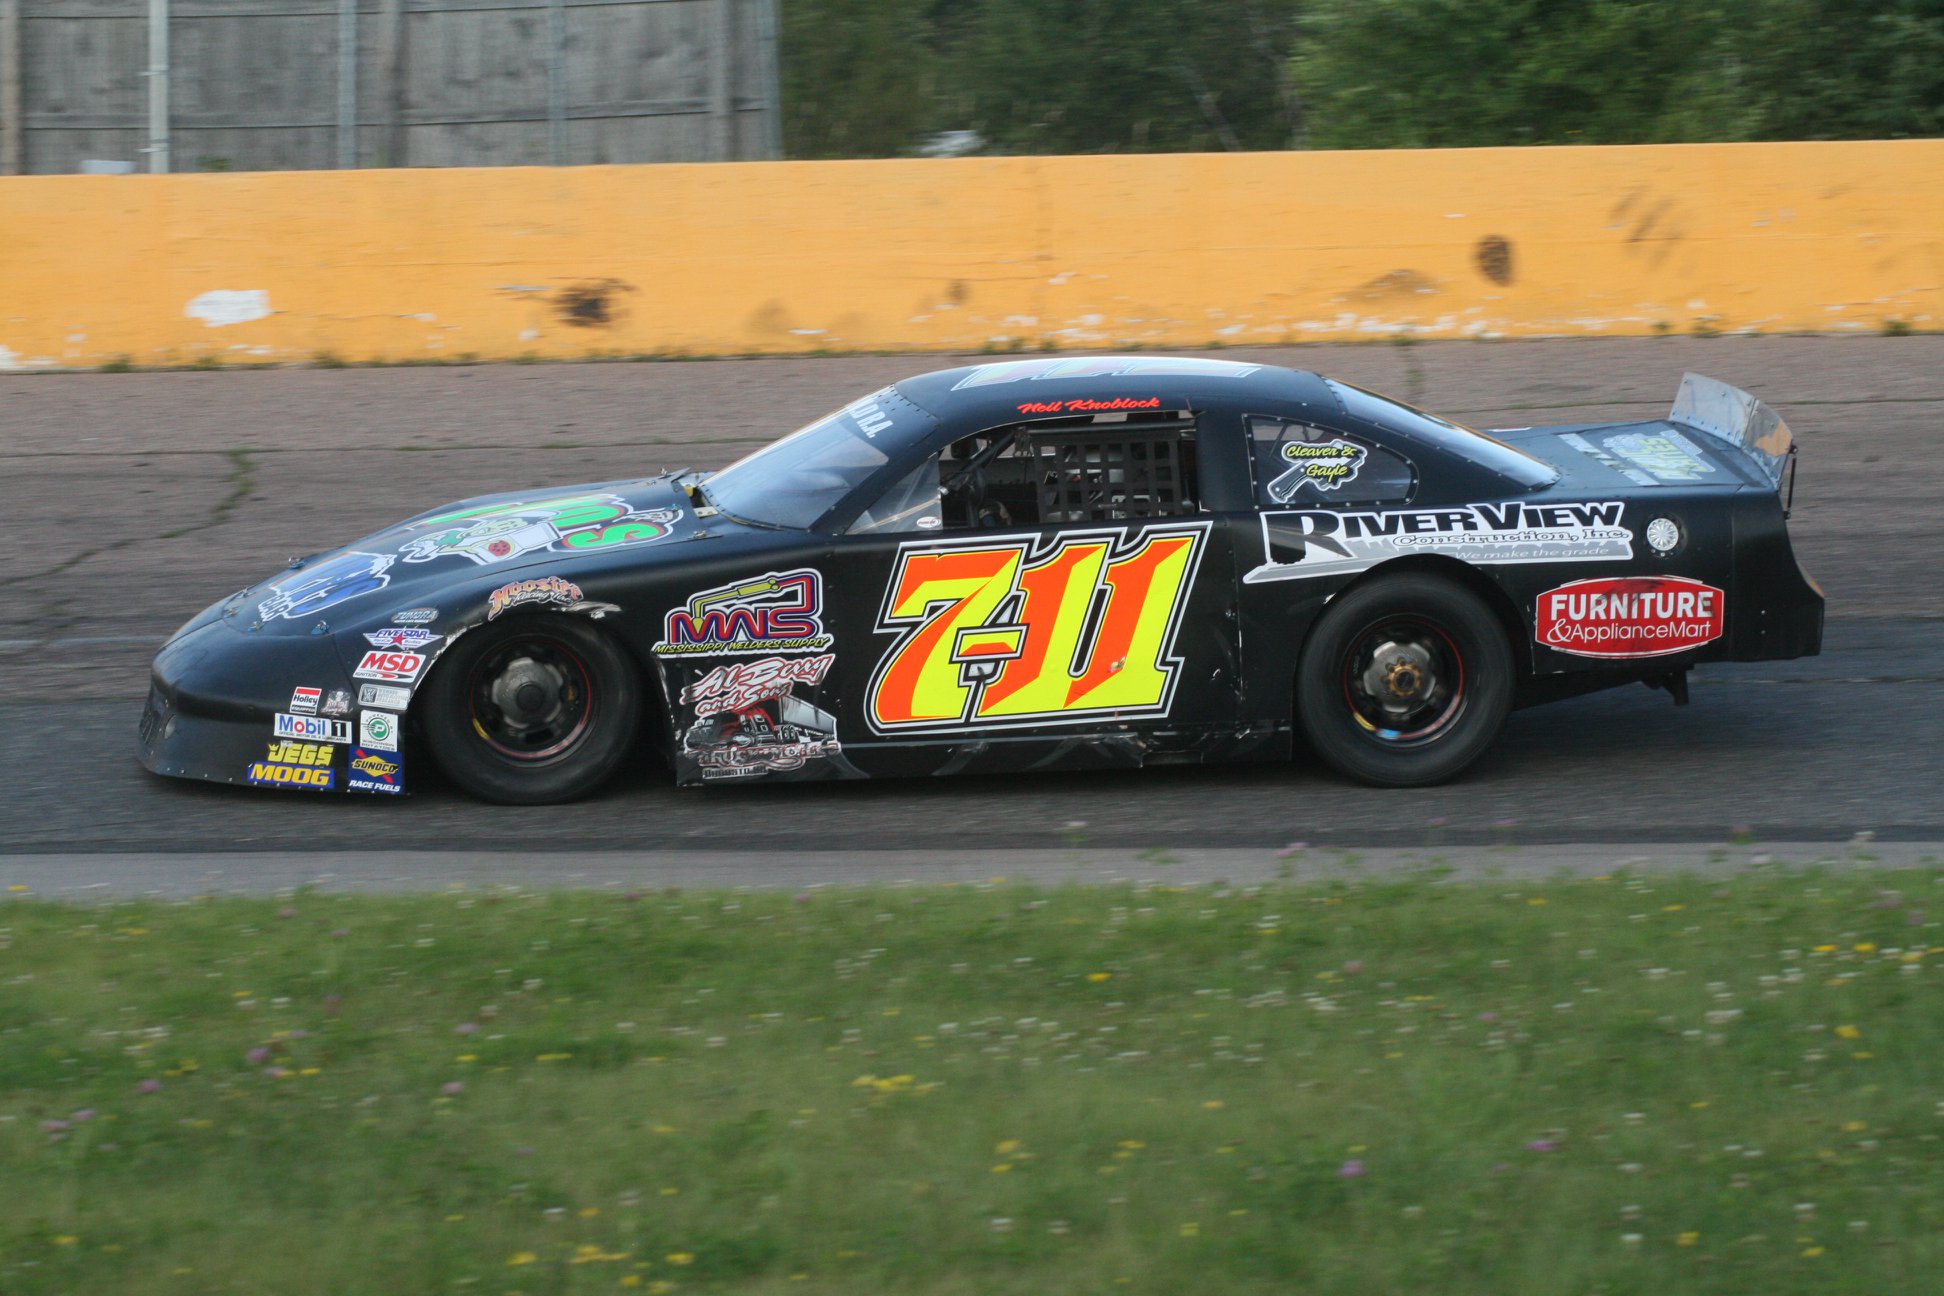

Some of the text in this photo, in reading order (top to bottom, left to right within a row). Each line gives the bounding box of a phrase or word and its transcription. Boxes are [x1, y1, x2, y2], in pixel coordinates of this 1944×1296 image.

[1017, 397, 1160, 414] Neil Knoblock
[1286, 445, 1357, 457] Cleaver &
[1306, 464, 1348, 483] Gayle
[1393, 528, 1630, 547] Construction, Inc.
[1454, 546, 1610, 560] We make the grade
[1551, 591, 1714, 621] FURNITURE
[375, 629, 428, 640] FIVE STAR
[655, 637, 829, 653] MISSISSIPPI WELDERS SUPPLY
[360, 652, 421, 673] MSD
[293, 694, 318, 706] Holley
[699, 693, 737, 712] and
[278, 715, 326, 735] Mobil
[268, 743, 334, 766] JEGS
[250, 765, 332, 786] MOOG
[354, 760, 399, 774] SUNOCO
[349, 780, 401, 792] RACE FUELS
